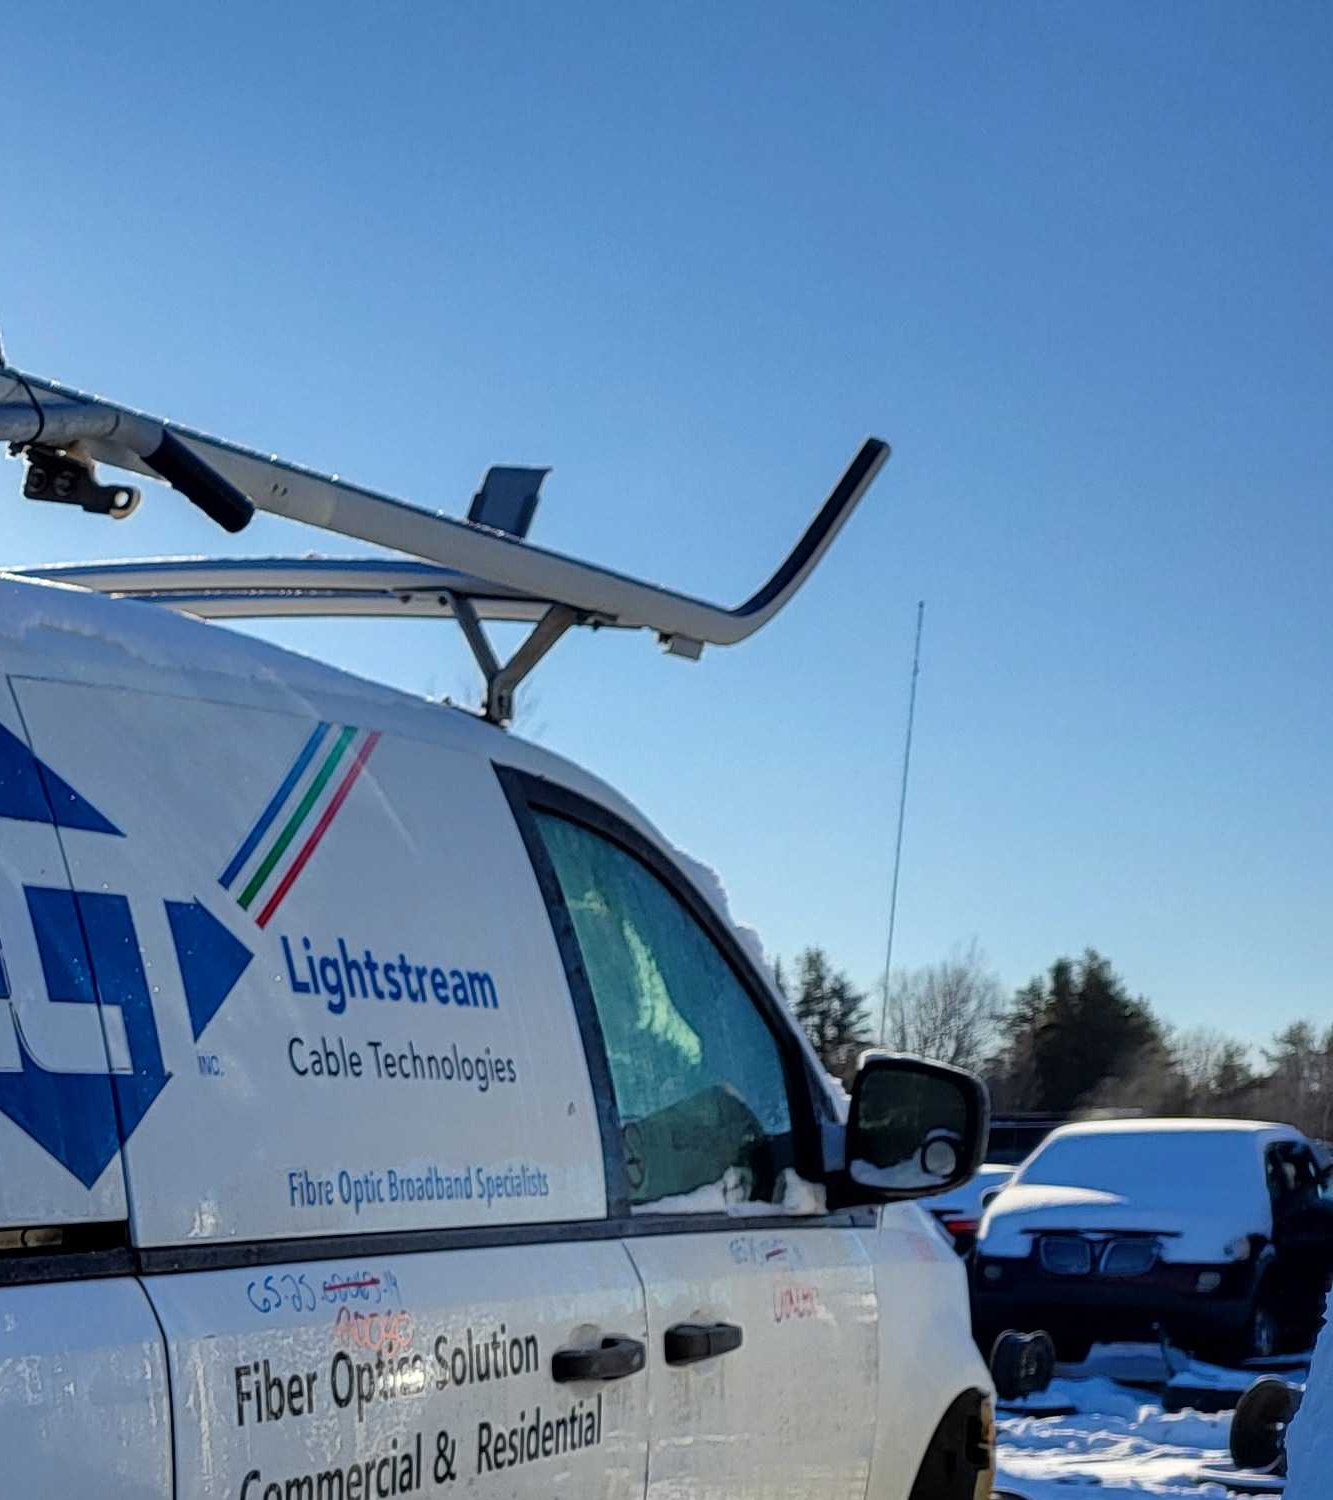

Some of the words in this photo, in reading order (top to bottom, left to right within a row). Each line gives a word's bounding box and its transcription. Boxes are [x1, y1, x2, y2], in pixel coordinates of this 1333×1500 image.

[281, 936, 499, 1014] Lightstream
[288, 1036, 363, 1078] Cable
[367, 1041, 517, 1092] Technologies
[288, 1170, 333, 1208] Fibre
[338, 1169, 383, 1214] Optic
[389, 1167, 473, 1203] Broadband
[477, 1166, 550, 1207] Specialists
[235, 1360, 317, 1427] Fiber
[331, 1346, 424, 1422] Optics
[434, 1324, 539, 1391] Solution
[433, 1430, 457, 1484] &
[476, 1393, 602, 1475] Residential
